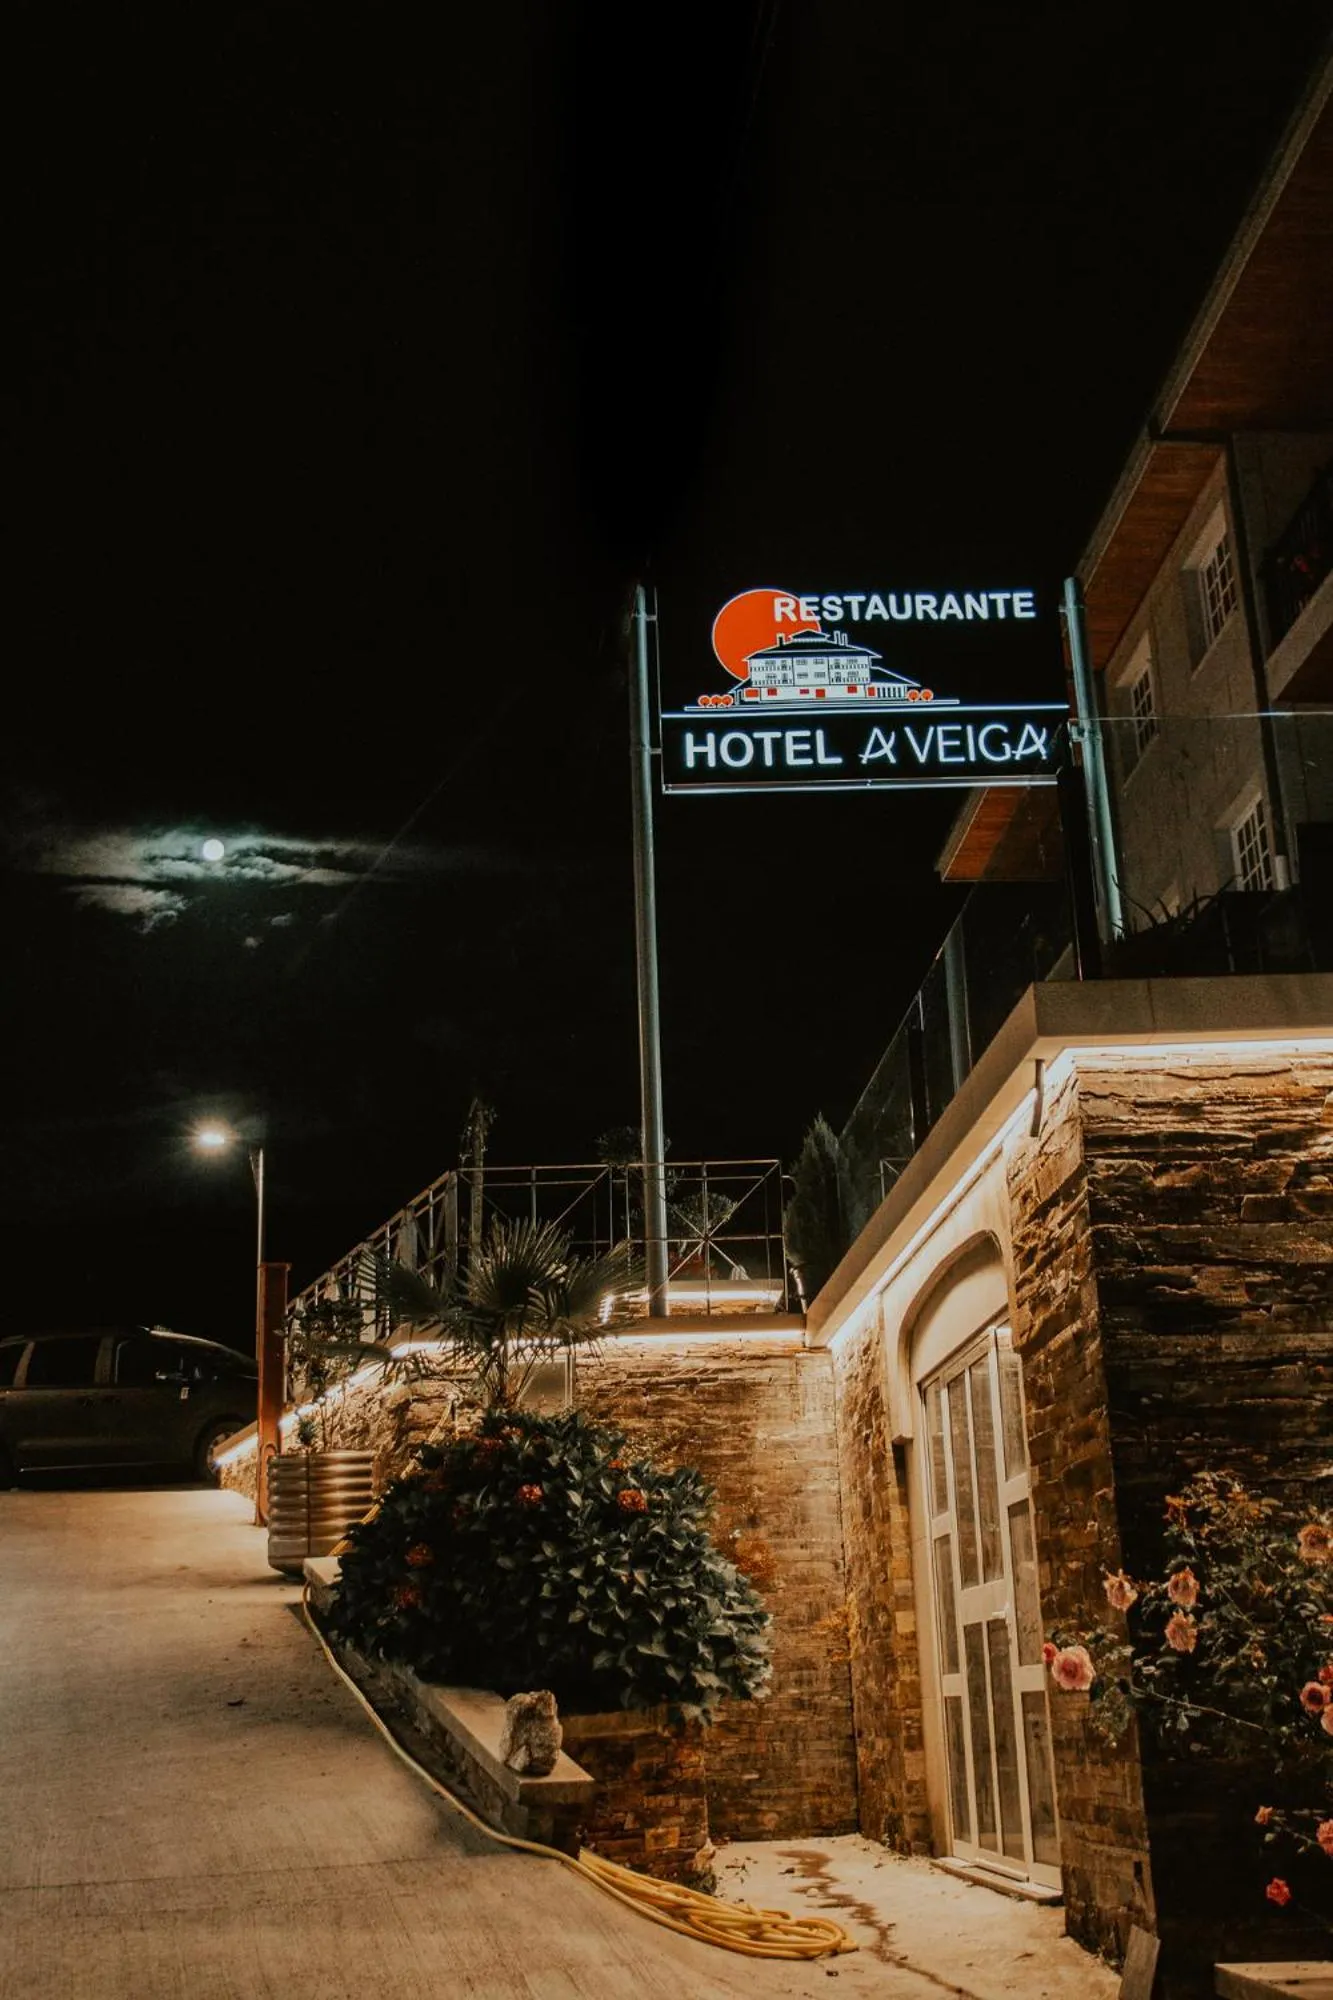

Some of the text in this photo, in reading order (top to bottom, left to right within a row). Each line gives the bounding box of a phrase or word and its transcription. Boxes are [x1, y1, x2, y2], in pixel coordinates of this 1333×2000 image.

[773, 591, 1036, 622] RESTAURANTE
[684, 722, 1049, 769] HOTEL A VEIGA
